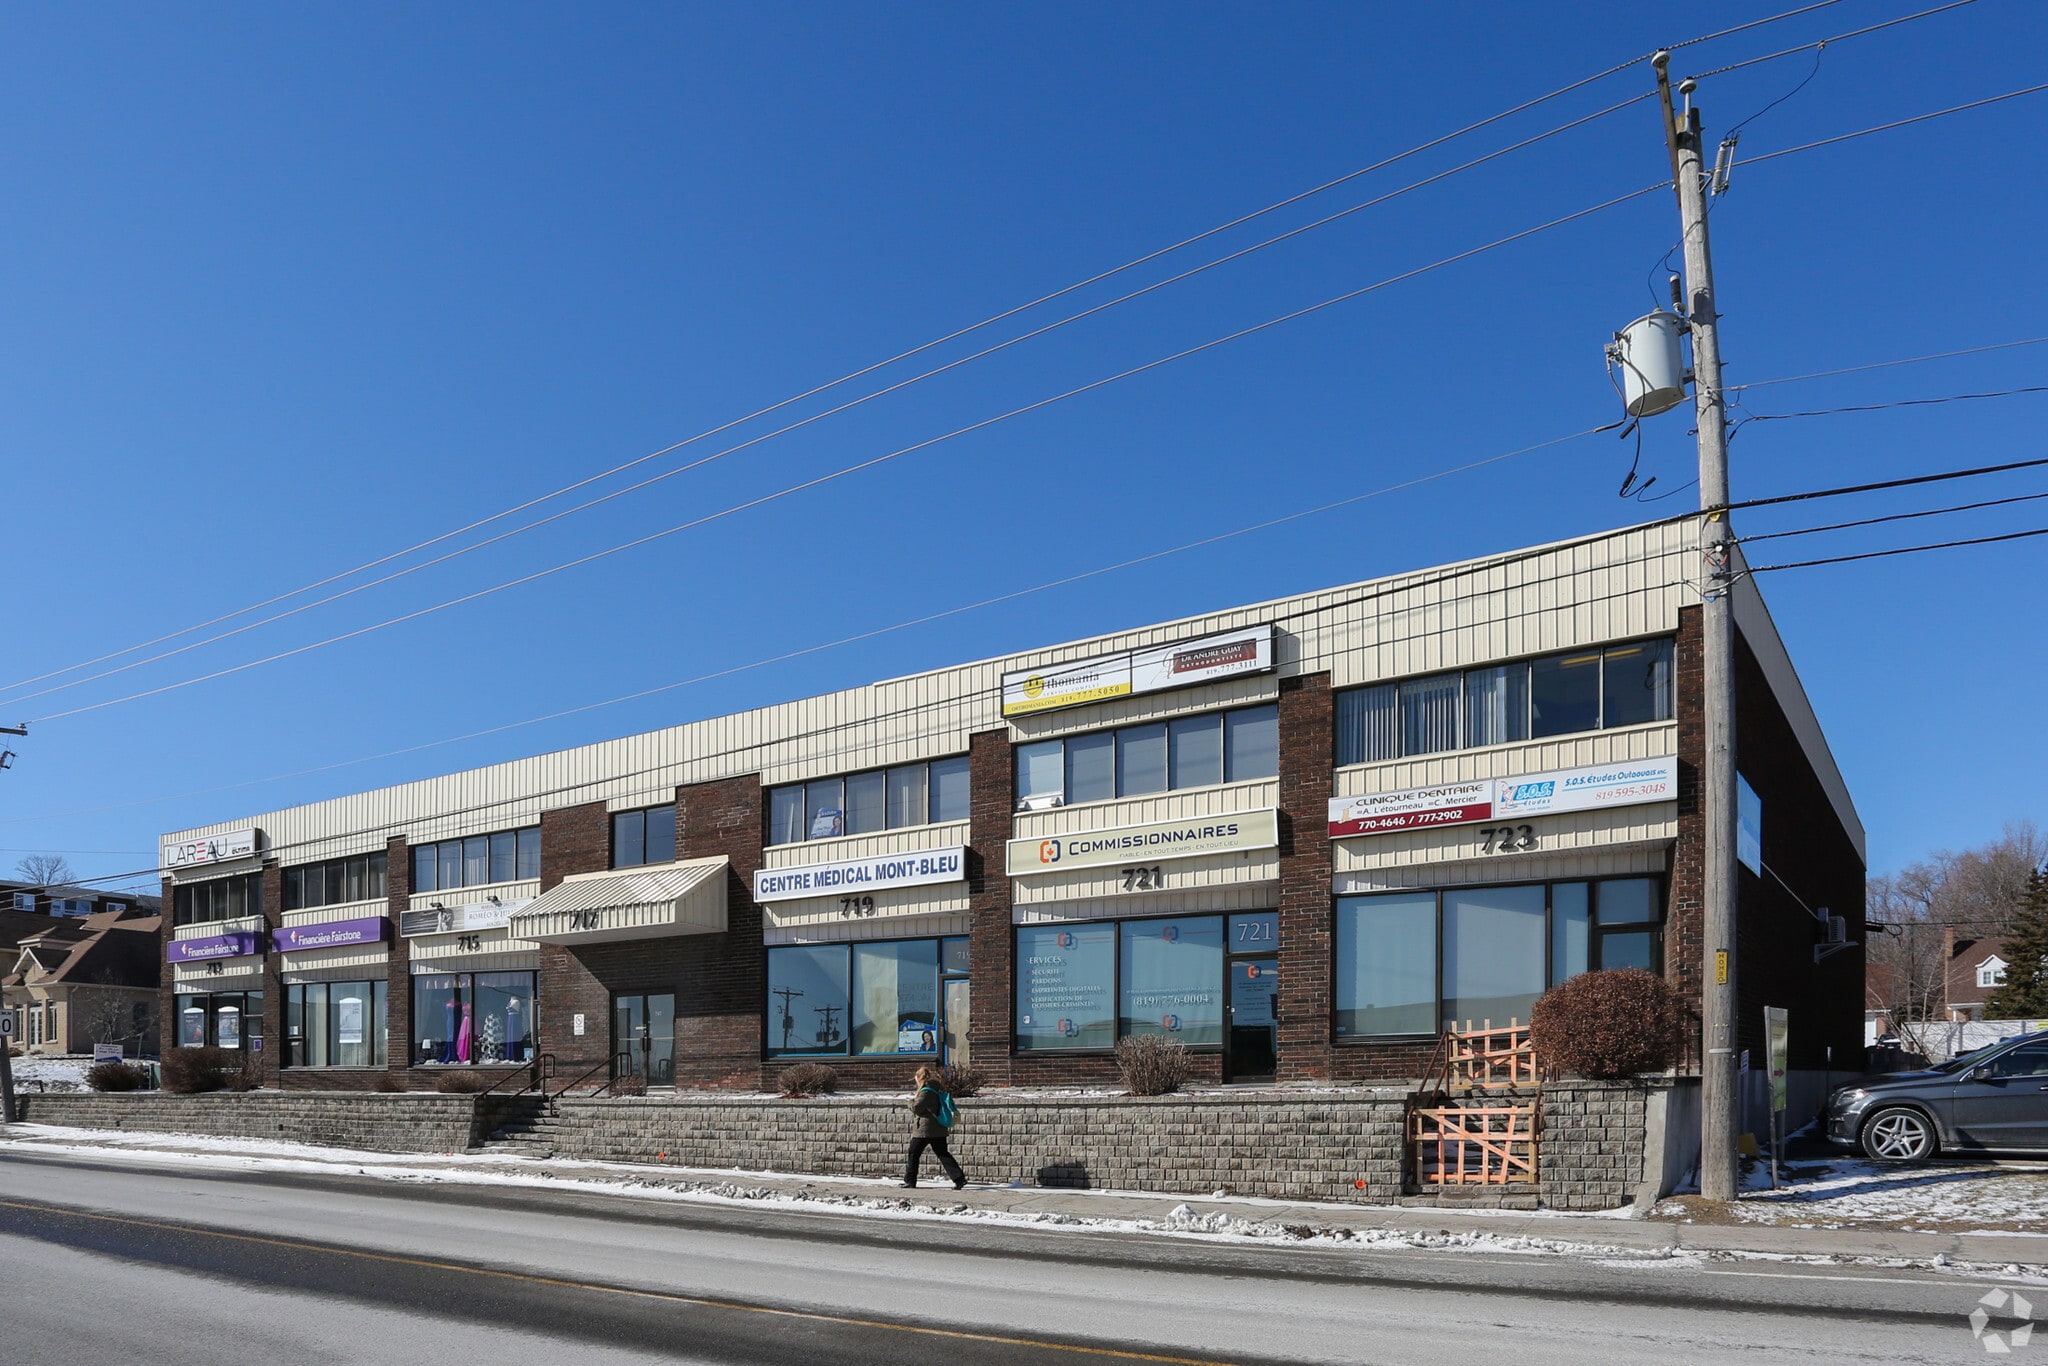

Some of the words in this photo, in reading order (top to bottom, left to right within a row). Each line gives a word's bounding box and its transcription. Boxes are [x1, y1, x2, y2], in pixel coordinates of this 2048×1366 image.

[1356, 792, 1415, 806] CLINIQUE
[1418, 784, 1483, 799] DENTAIRE
[1445, 796, 1477, 805] Mercier
[1595, 791, 1613, 800] 819
[1615, 783, 1666, 798] 595-3048
[1358, 817, 1406, 830] 770-4646
[1418, 810, 1463, 824] 777-2902
[1069, 824, 1238, 855] COMMISSIONNAIRES
[1480, 824, 1533, 851] 723
[167, 838, 228, 866] LAREAU
[760, 872, 811, 893] CENTRE
[814, 864, 872, 888] MÉDICAL
[875, 855, 959, 880] MONT-BLEU
[1122, 866, 1160, 889] 721
[840, 896, 874, 916] 719
[298, 932, 331, 946] Financière
[331, 931, 362, 942] Fairstone
[1237, 922, 1273, 941] 721
[188, 945, 214, 957] Financière
[214, 944, 239, 955] Fairstone
[458, 935, 480, 950] 715
[206, 962, 223, 974] 713
[0, 1019, 11, 1032] 0
